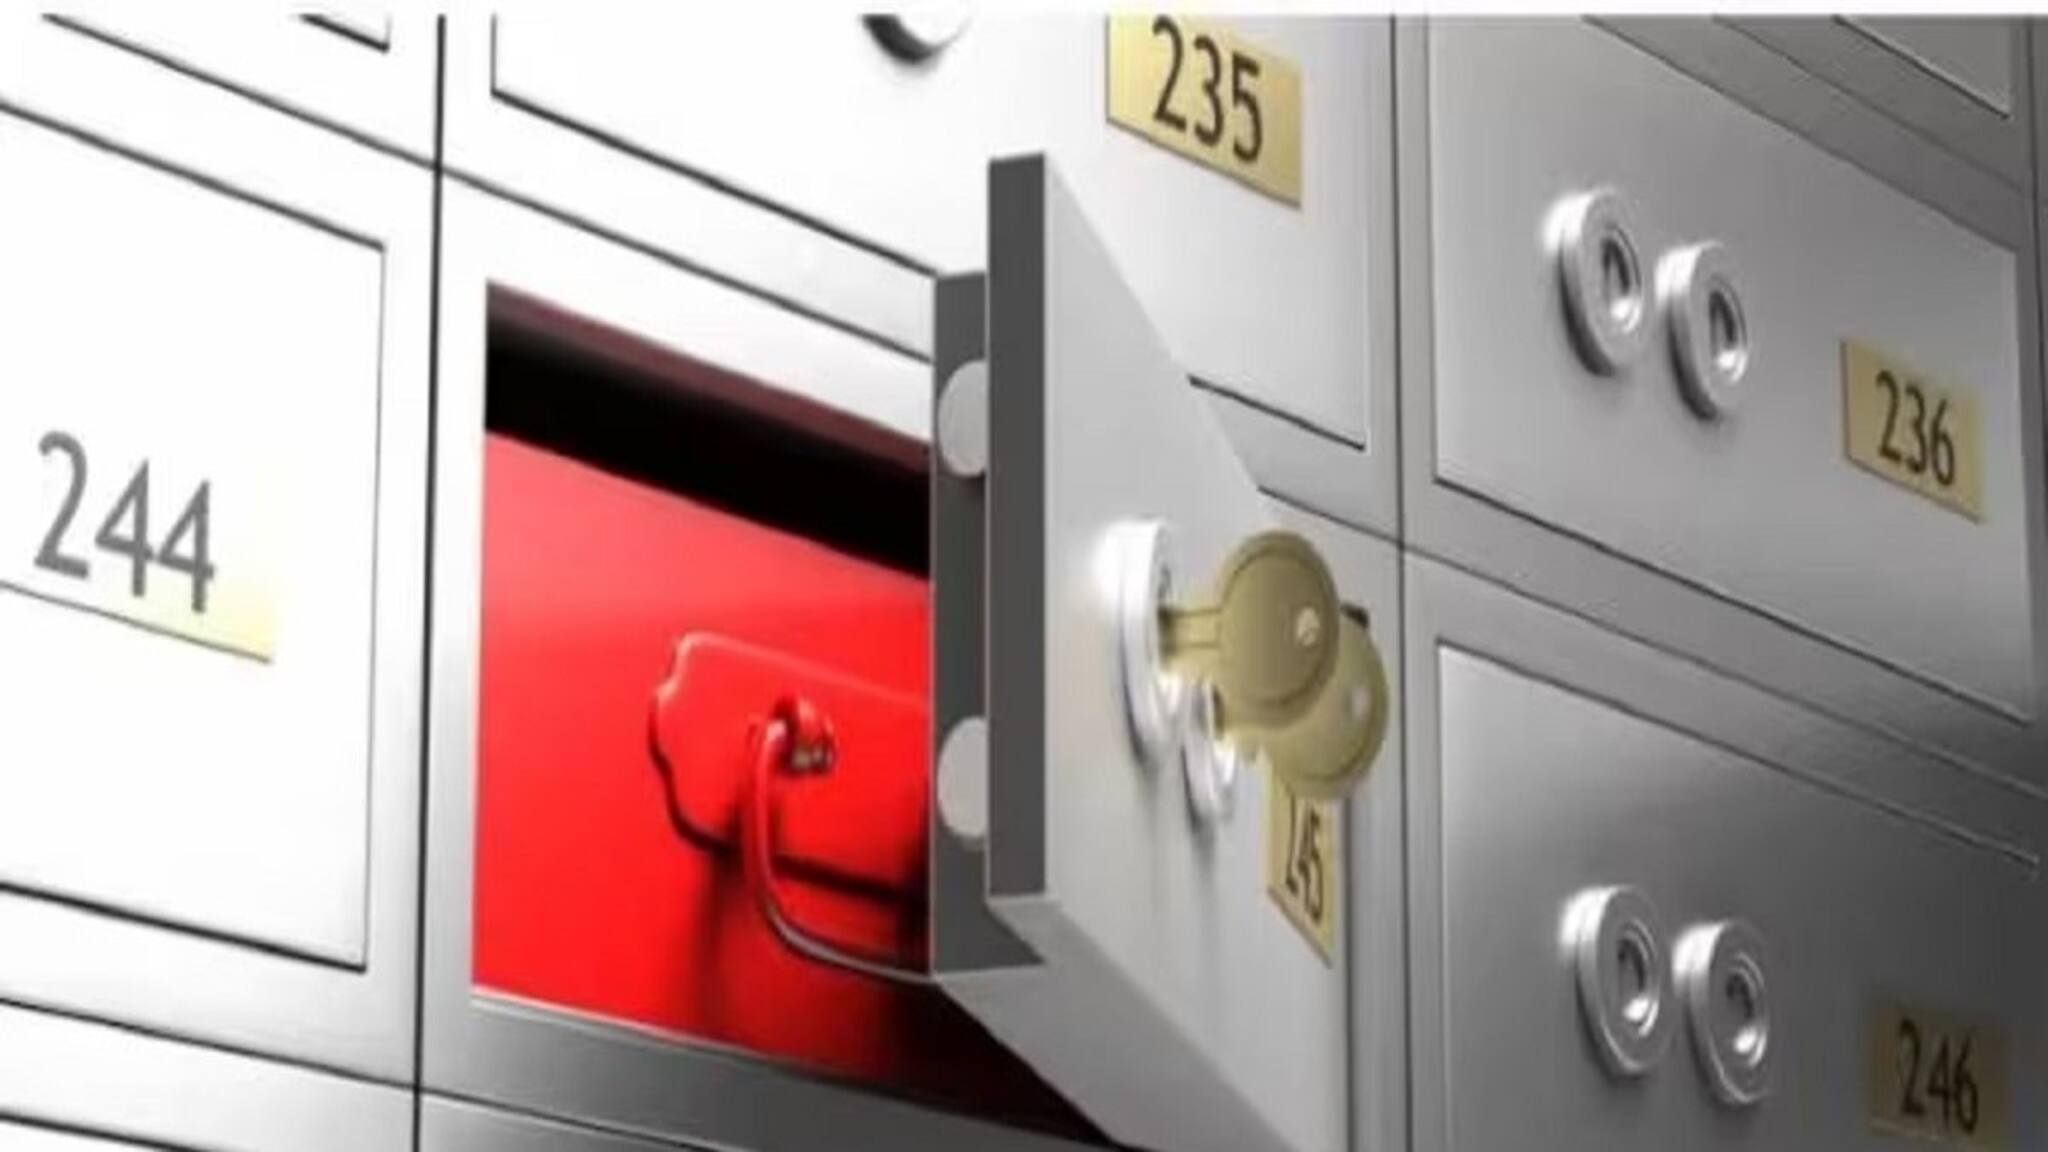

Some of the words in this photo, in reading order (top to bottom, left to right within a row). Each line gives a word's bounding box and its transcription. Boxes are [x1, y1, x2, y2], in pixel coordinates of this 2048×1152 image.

[1152, 15, 1263, 164] 235
[1876, 370, 1955, 486] 236
[34, 430, 216, 614] 244
[1899, 1019, 1979, 1135] 246
